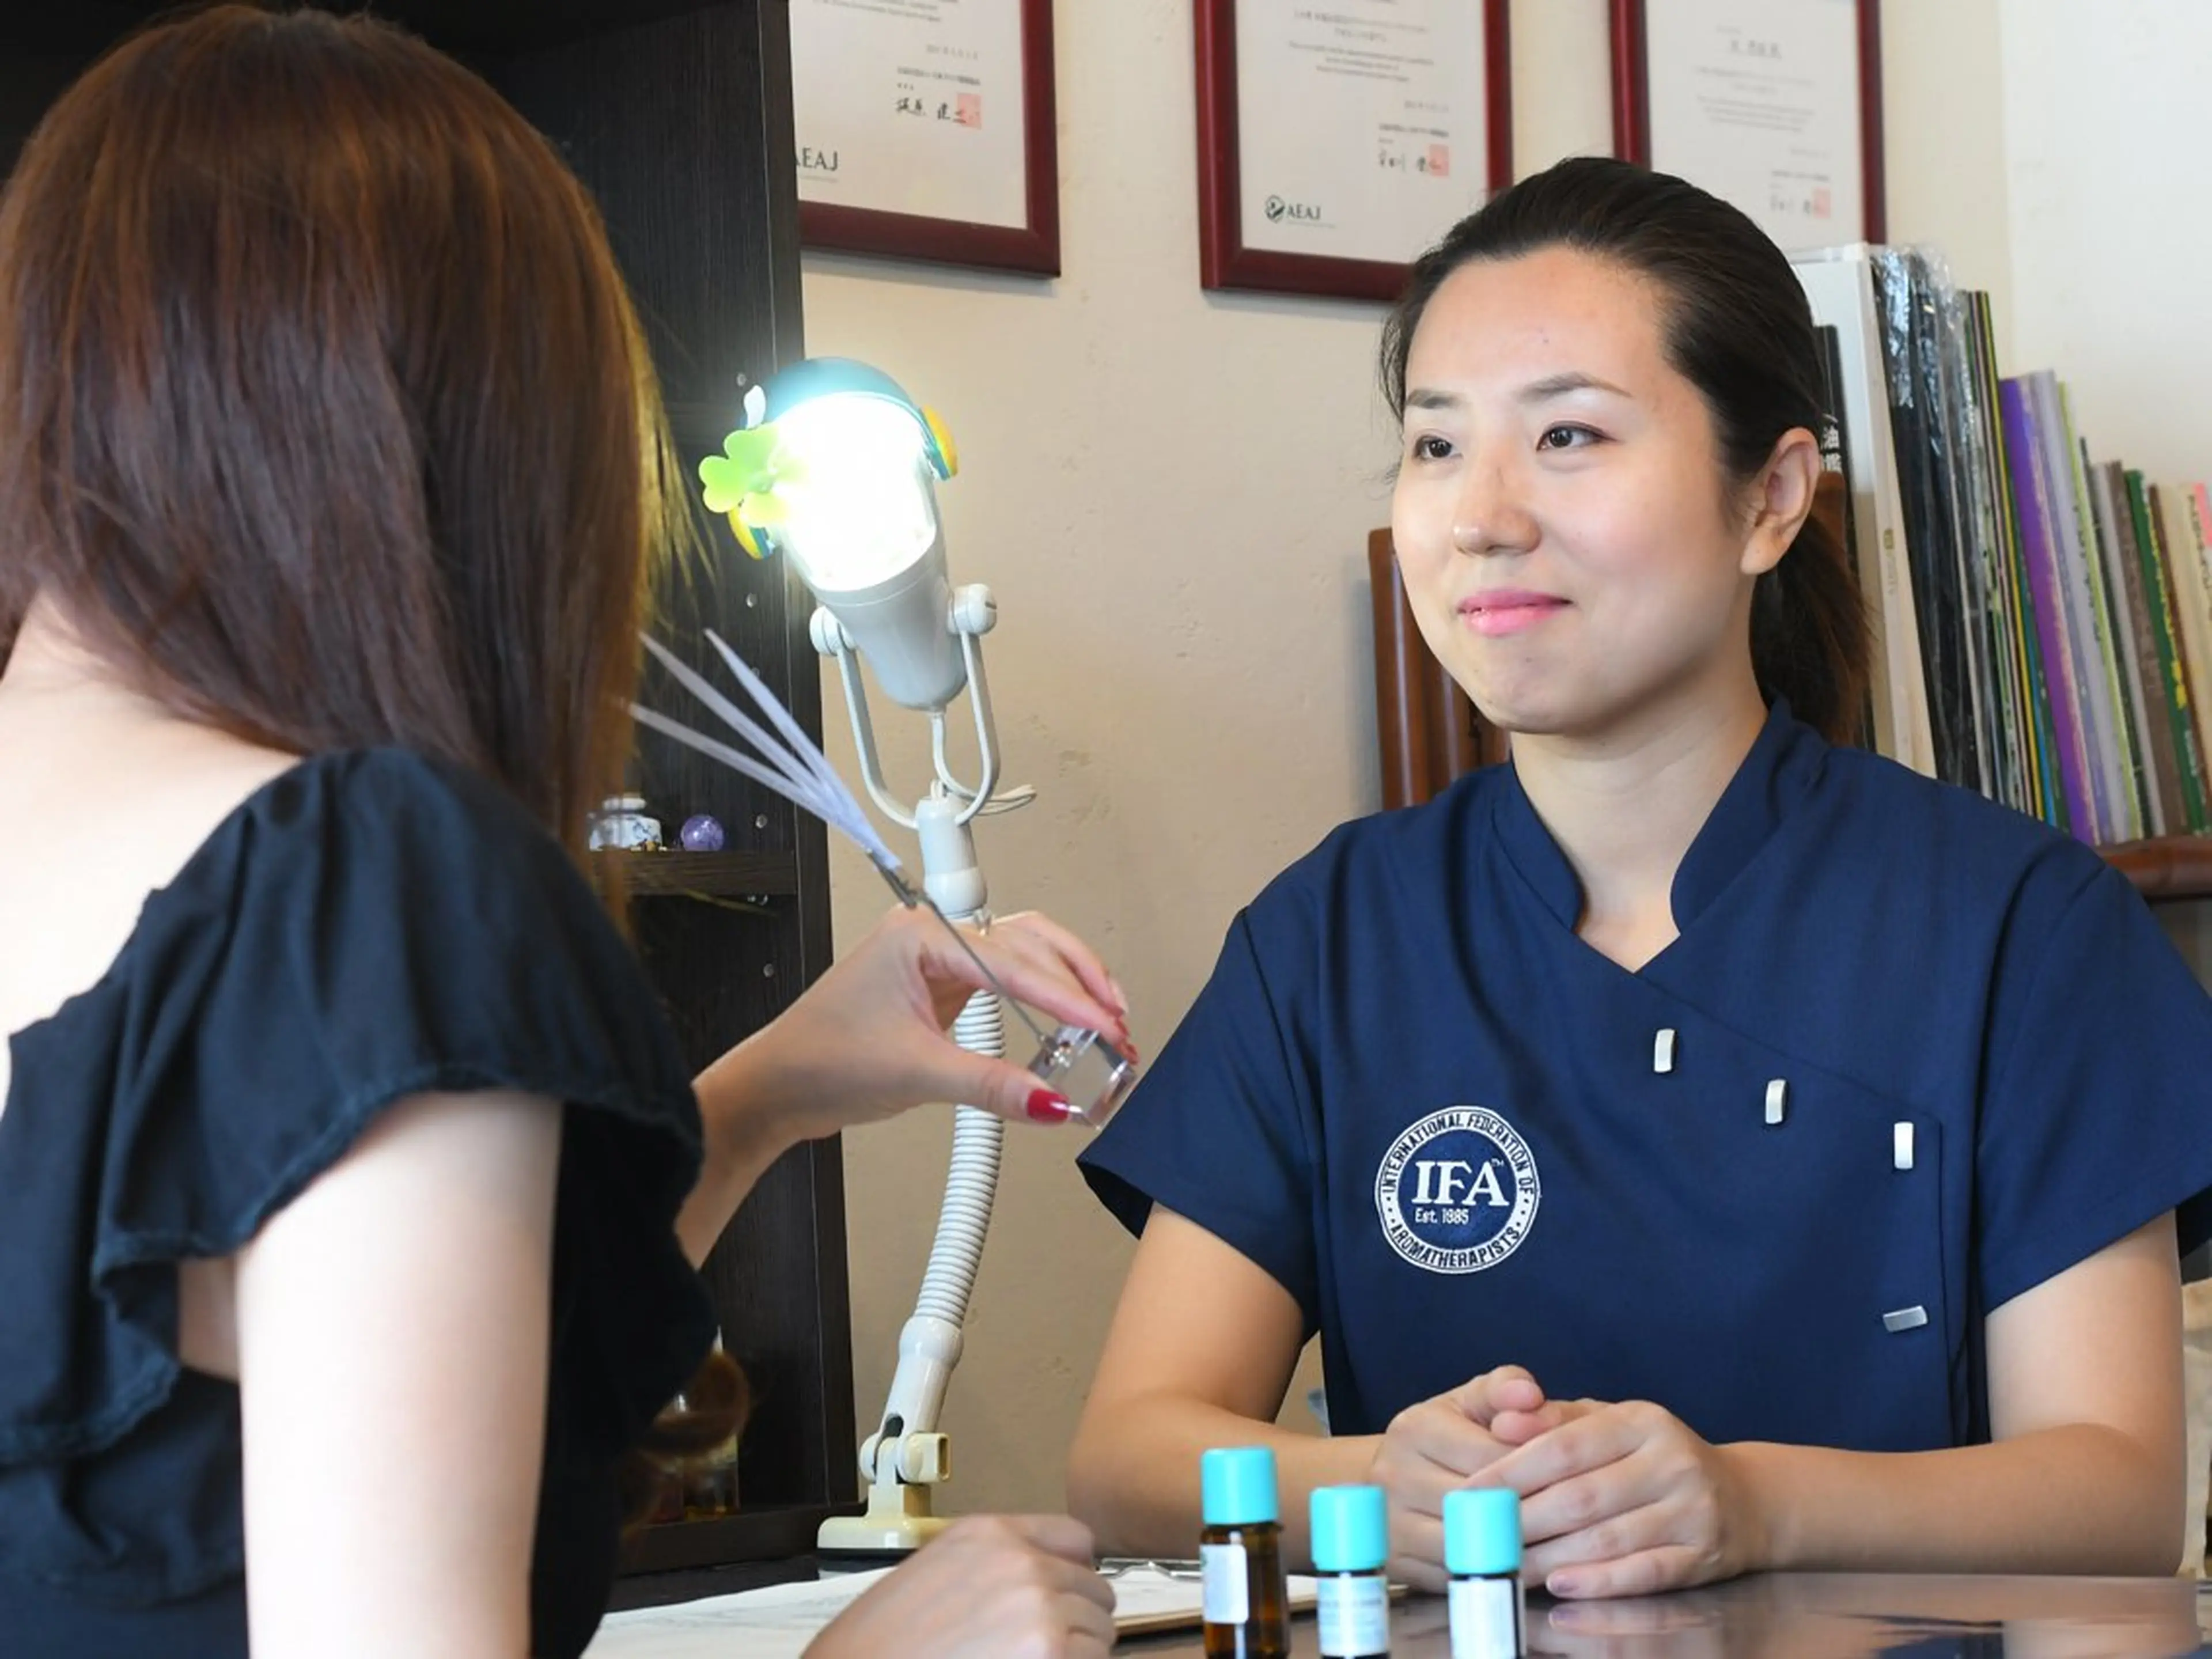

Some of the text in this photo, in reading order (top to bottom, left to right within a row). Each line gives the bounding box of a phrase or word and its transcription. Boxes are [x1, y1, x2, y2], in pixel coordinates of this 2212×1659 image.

[796, 147, 838, 172] EAJ
[1288, 203, 1321, 221] AEAJ
[1382, 1113, 1535, 1195] INTERNATIONAL FEDERATION OF
[1411, 1160, 1510, 1207] IFA
[1415, 1208, 1469, 1224] Est. 1985
[1392, 1224, 1519, 1267] AROMATHERAPISTS
